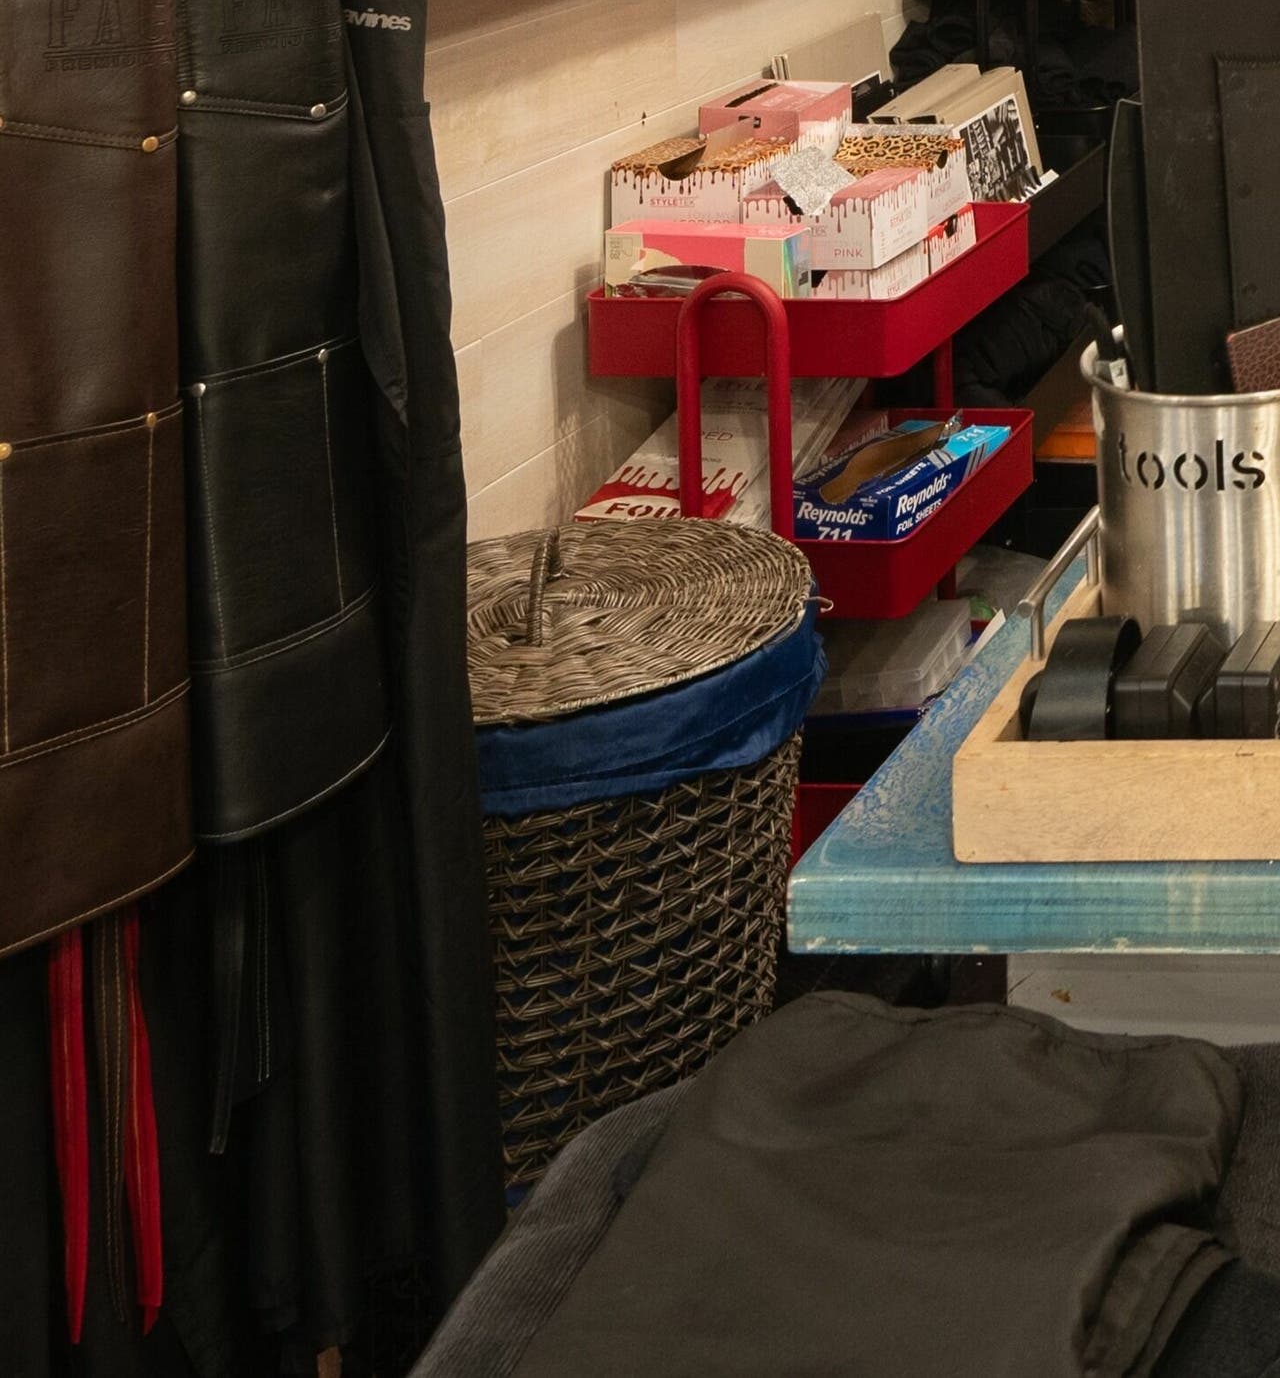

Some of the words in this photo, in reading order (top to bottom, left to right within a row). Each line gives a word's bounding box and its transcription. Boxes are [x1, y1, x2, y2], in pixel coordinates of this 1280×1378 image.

[344, 8, 411, 31] avines
[650, 198, 695, 206] STYLETEK
[834, 249, 863, 258] PINK
[700, 431, 733, 442] ED
[1118, 432, 1266, 490] tools
[895, 473, 948, 518] Reynolds
[797, 501, 868, 526] Reynolds
[896, 518, 913, 535] FOIL
[915, 498, 942, 523] SHEETS
